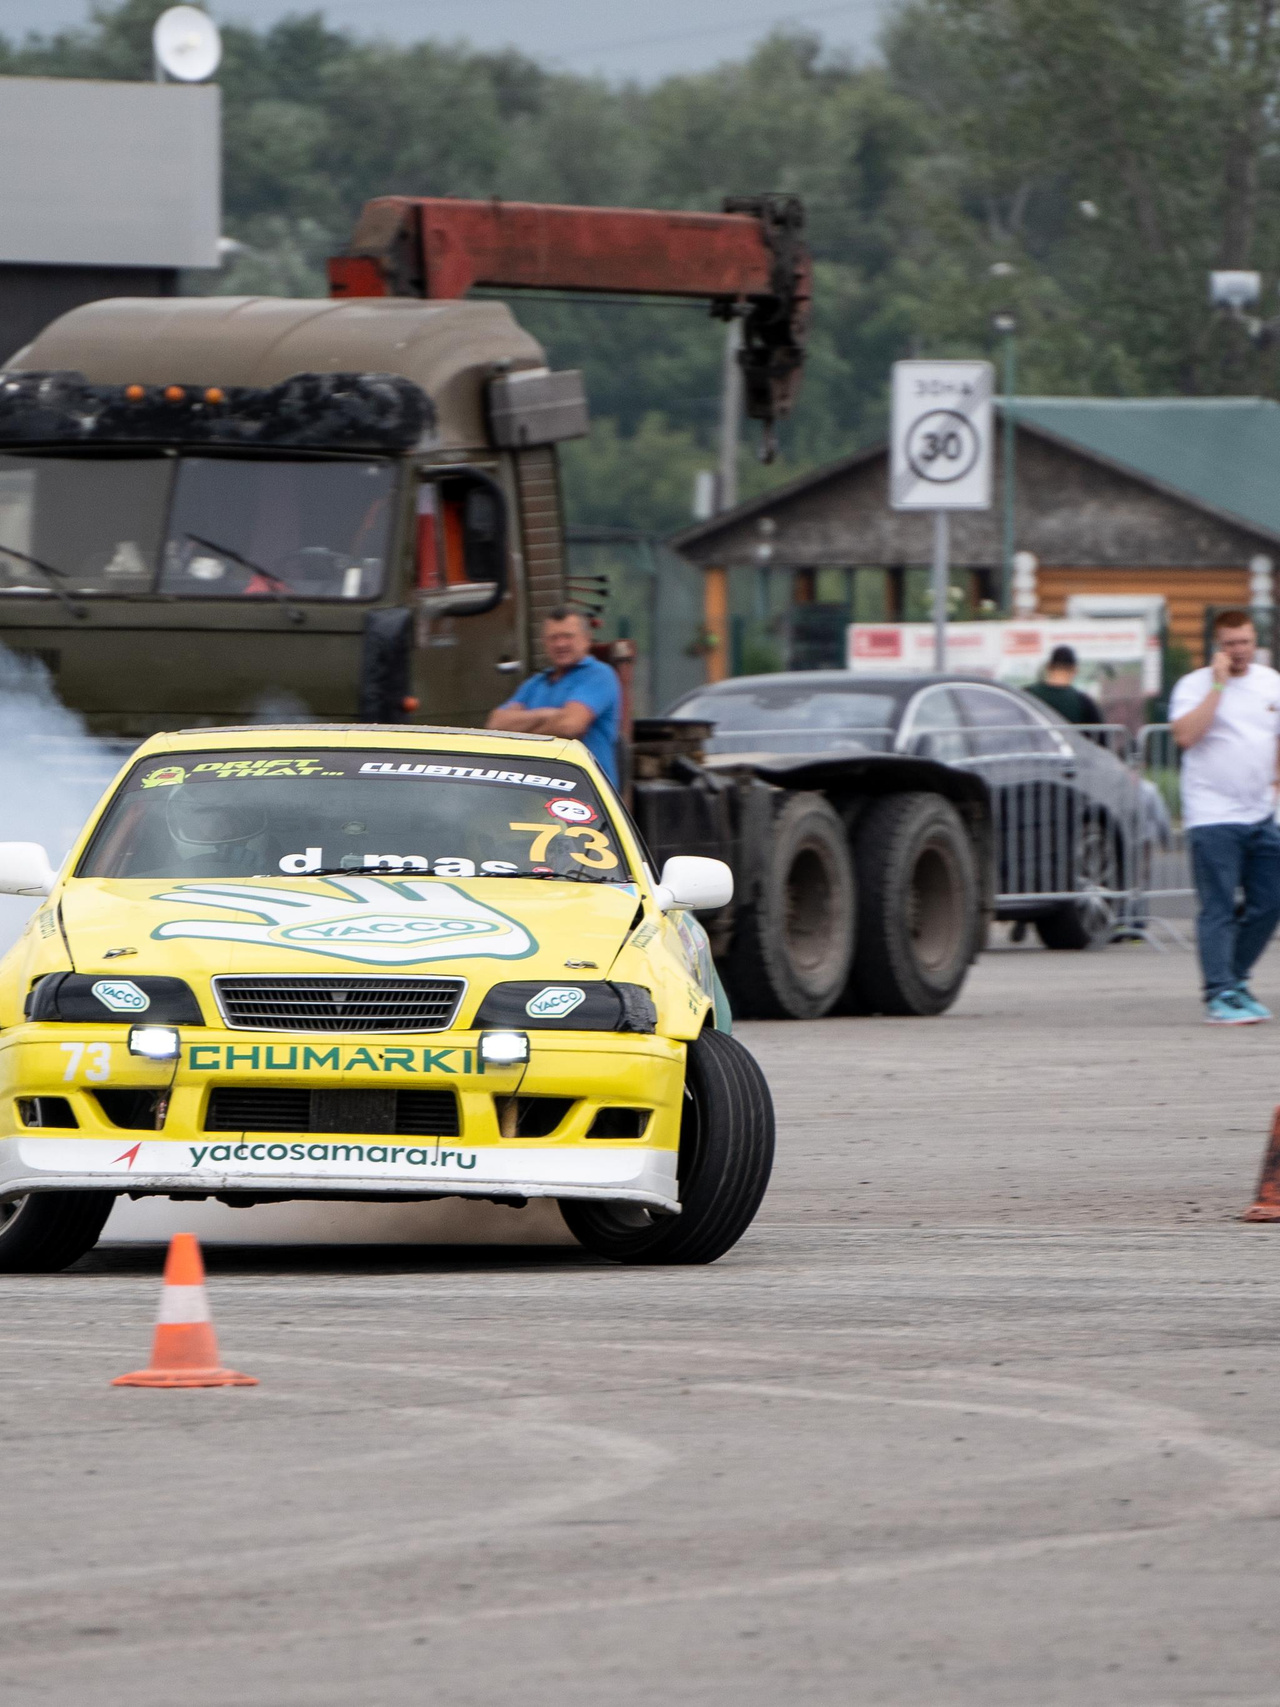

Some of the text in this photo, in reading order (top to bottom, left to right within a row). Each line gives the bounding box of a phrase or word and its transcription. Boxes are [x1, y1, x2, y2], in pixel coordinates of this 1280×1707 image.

[921, 431, 963, 461] 30
[192, 758, 320, 774] DRIFT
[358, 762, 577, 791] CLUBTURBO
[557, 805, 586, 815] 73
[509, 822, 619, 870] 73
[305, 921, 476, 938] YACCO
[103, 985, 141, 1006] YACCO
[534, 992, 577, 1012] YACCO
[60, 1042, 112, 1082] 73
[189, 1045, 486, 1075] CHUMARKI
[189, 1142, 478, 1170] yaccosamara.ru
